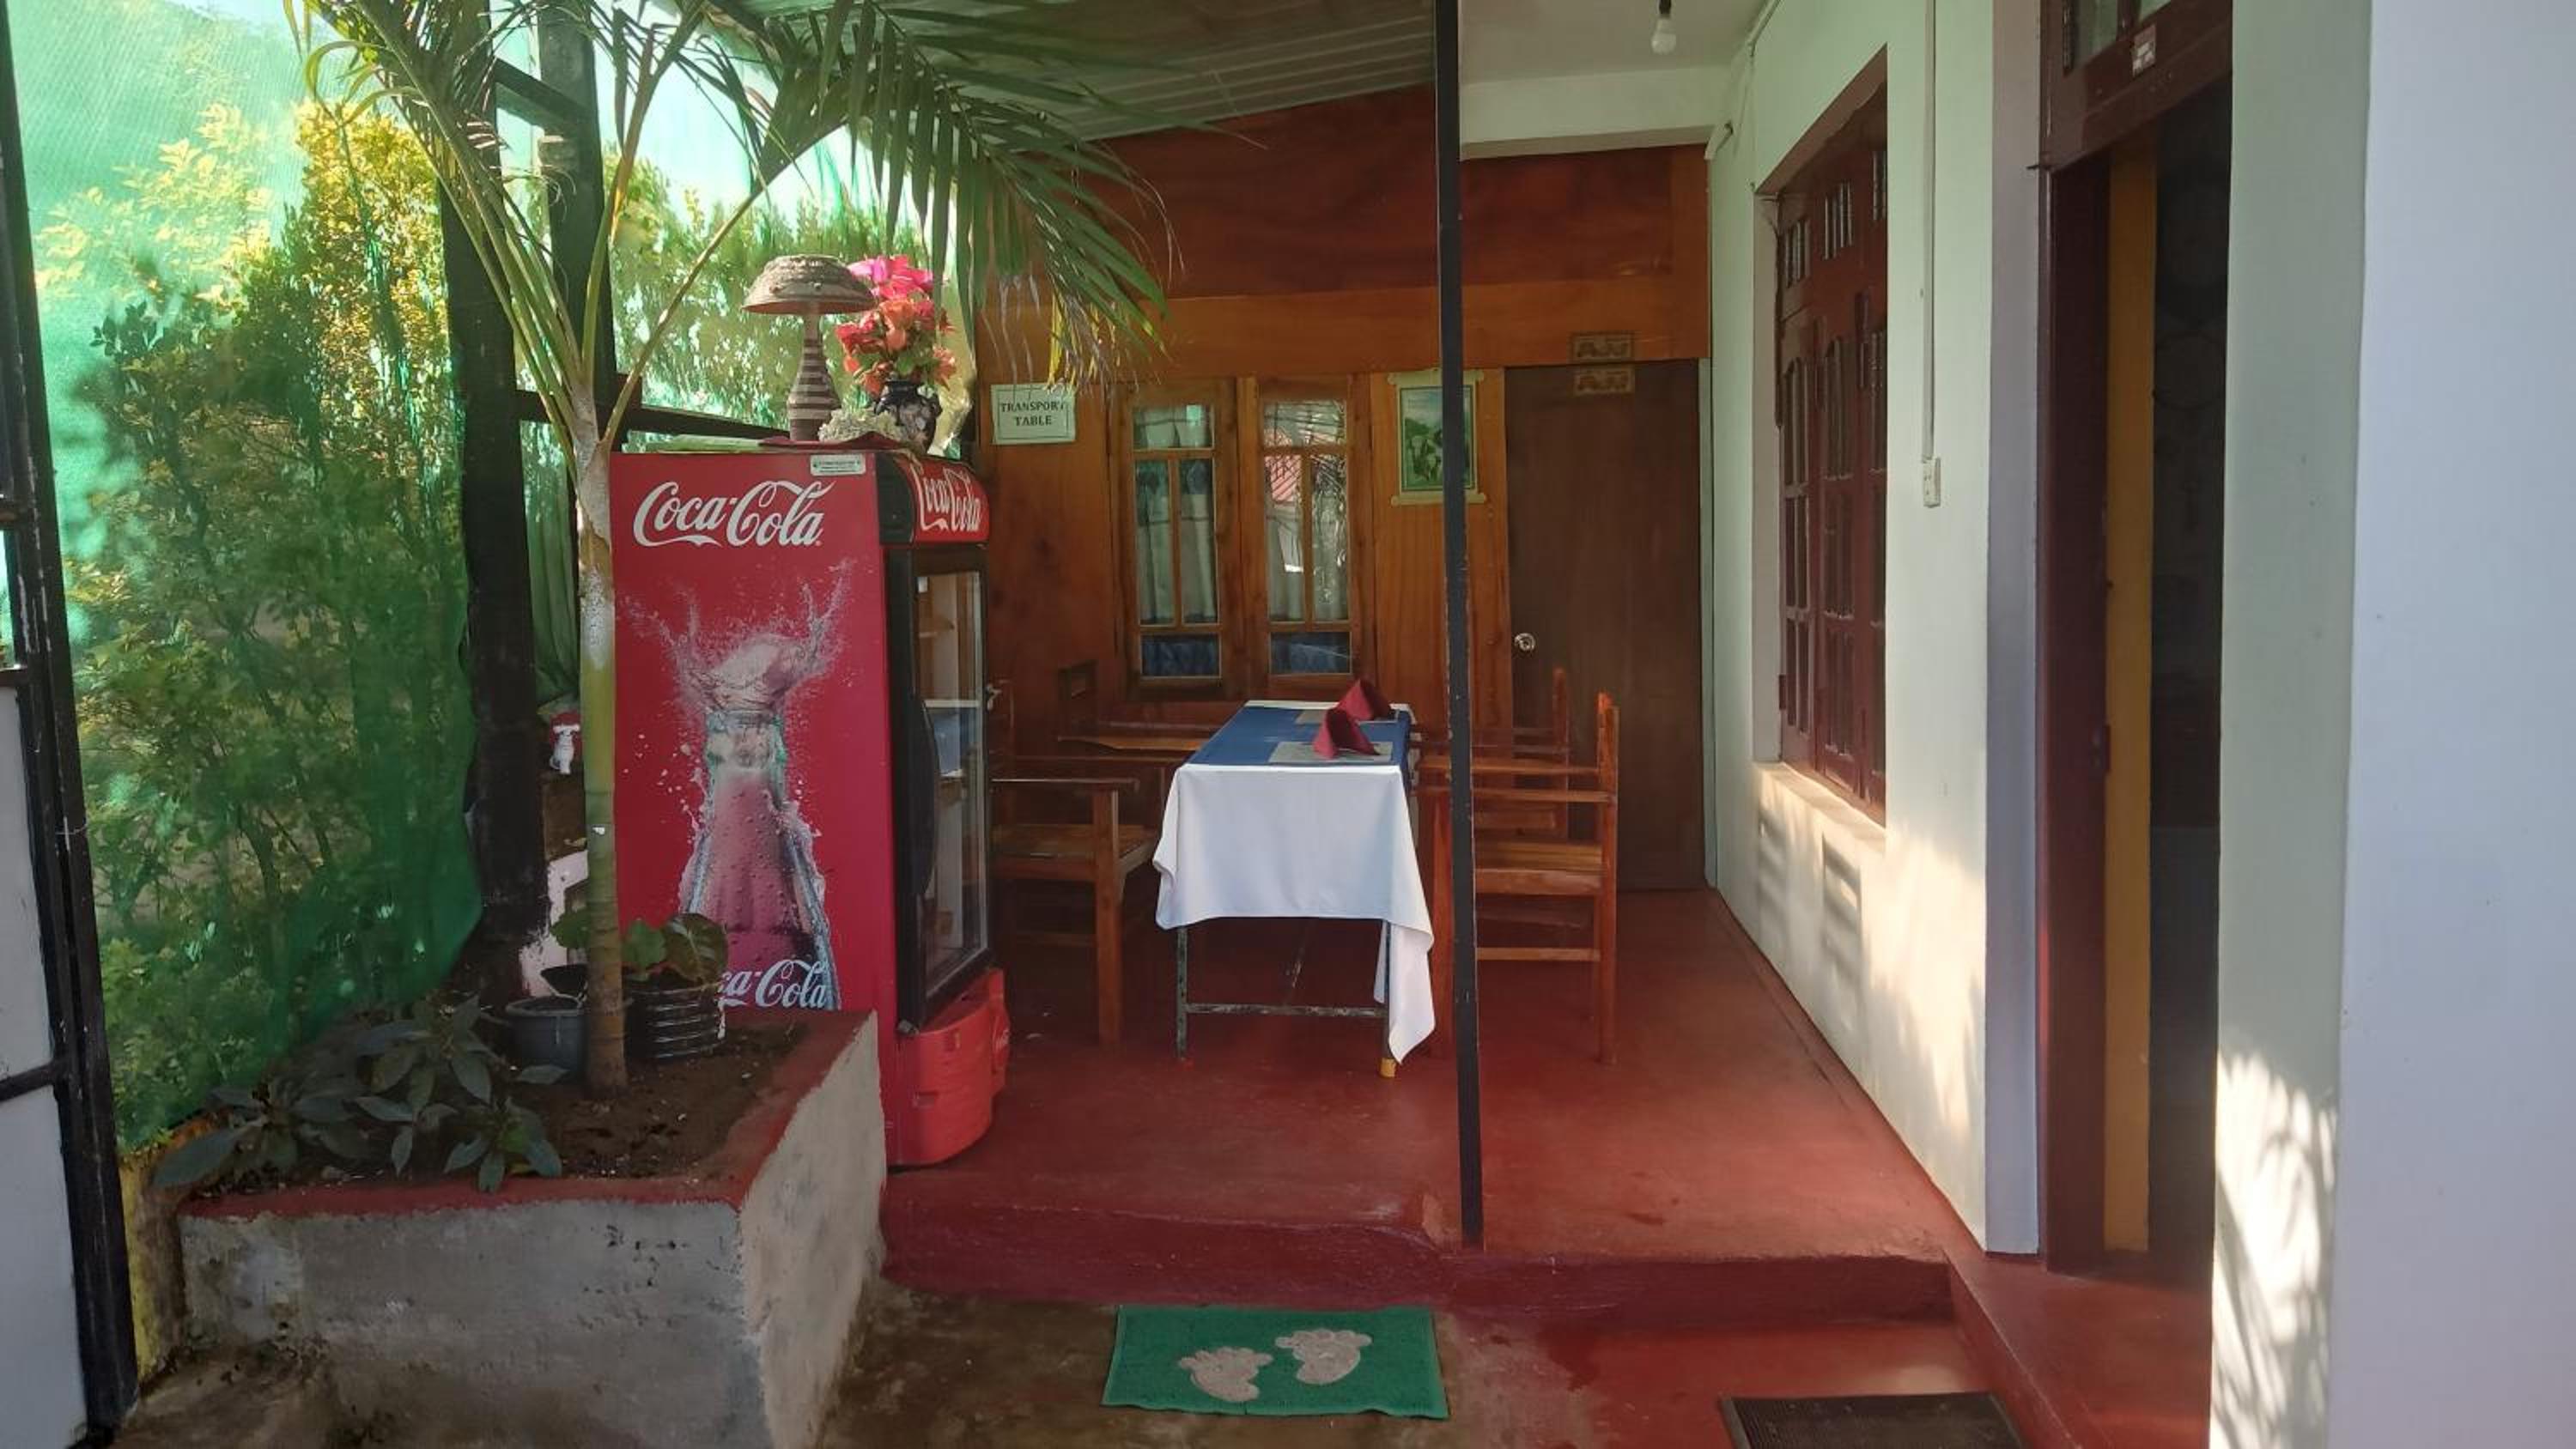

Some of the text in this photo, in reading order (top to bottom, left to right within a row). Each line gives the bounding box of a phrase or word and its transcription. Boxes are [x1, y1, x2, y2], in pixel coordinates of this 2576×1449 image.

[1001, 401, 1064, 412] TRANSPORT
[1015, 415, 1052, 426] TABLE
[634, 481, 835, 547] Coca-Cola
[910, 464, 981, 531] Coca-Cola
[714, 959, 827, 1008] ca-Cola
